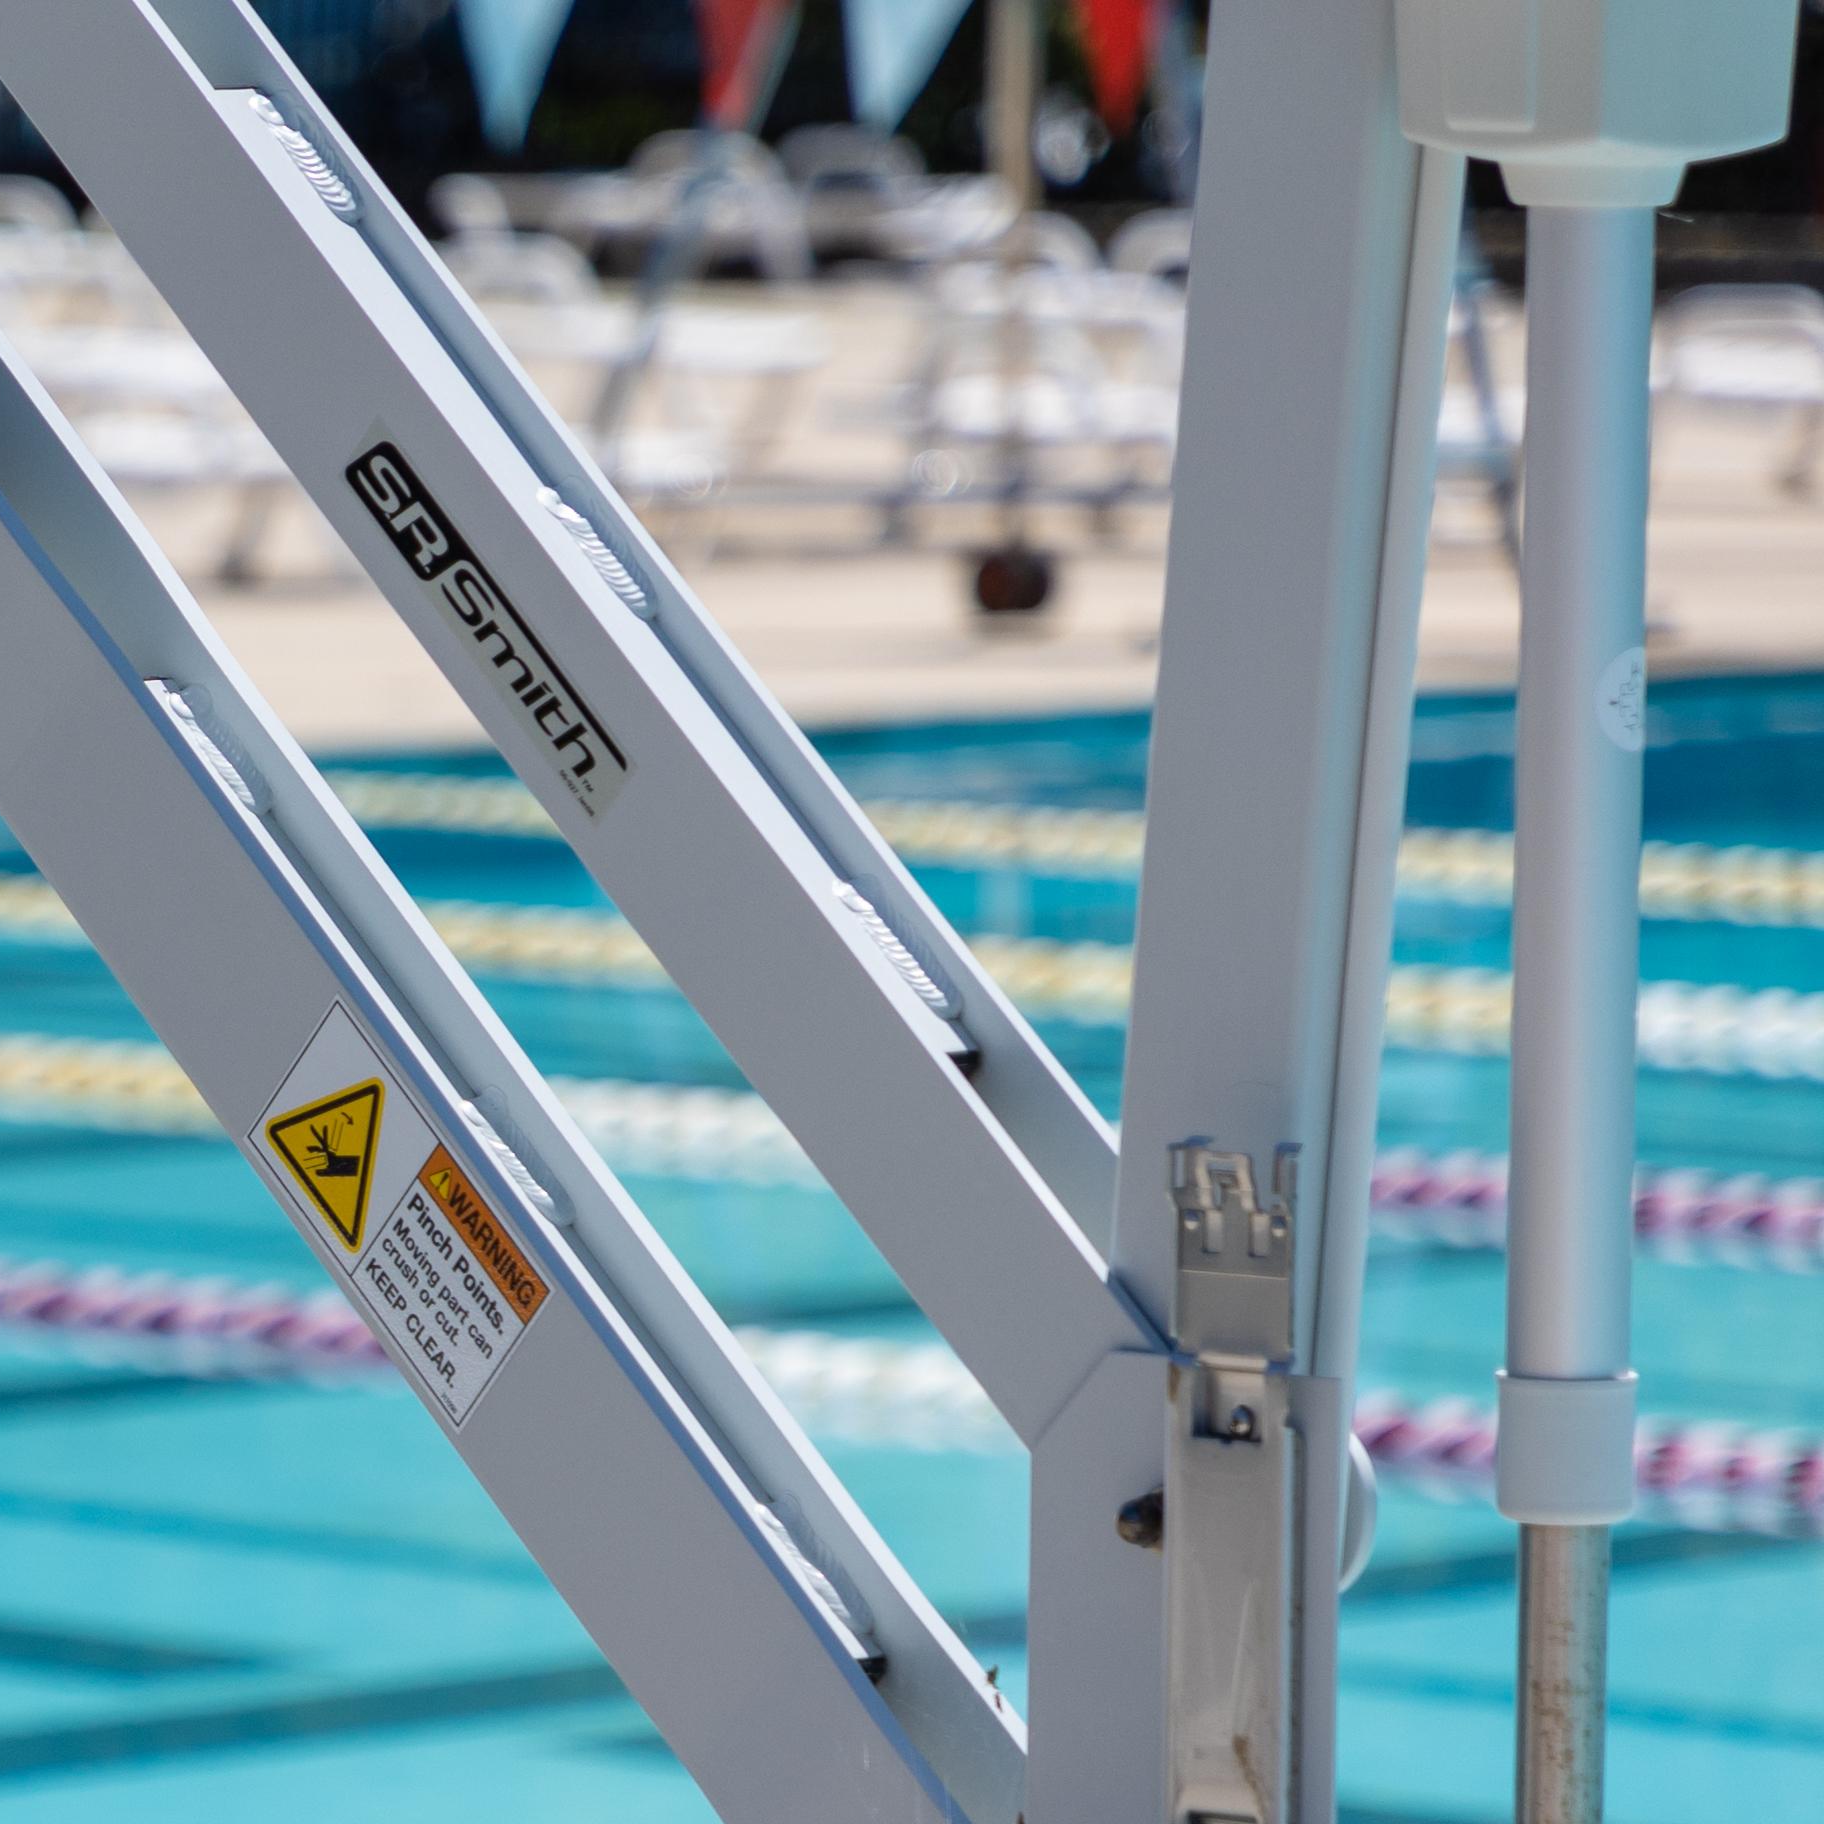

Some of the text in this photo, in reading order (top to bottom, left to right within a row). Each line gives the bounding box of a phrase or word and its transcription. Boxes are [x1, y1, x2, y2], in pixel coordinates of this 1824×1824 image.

[442, 564, 597, 779] Smith
[381, 1238, 460, 1347] crush or cut.
[392, 1218, 494, 1359] Moving part can
[406, 1192, 506, 1336] Pinch Points.
[447, 1182, 537, 1310] WARNING
[365, 1257, 408, 1313] KEEP
[405, 1311, 456, 1388] CLEAR.
